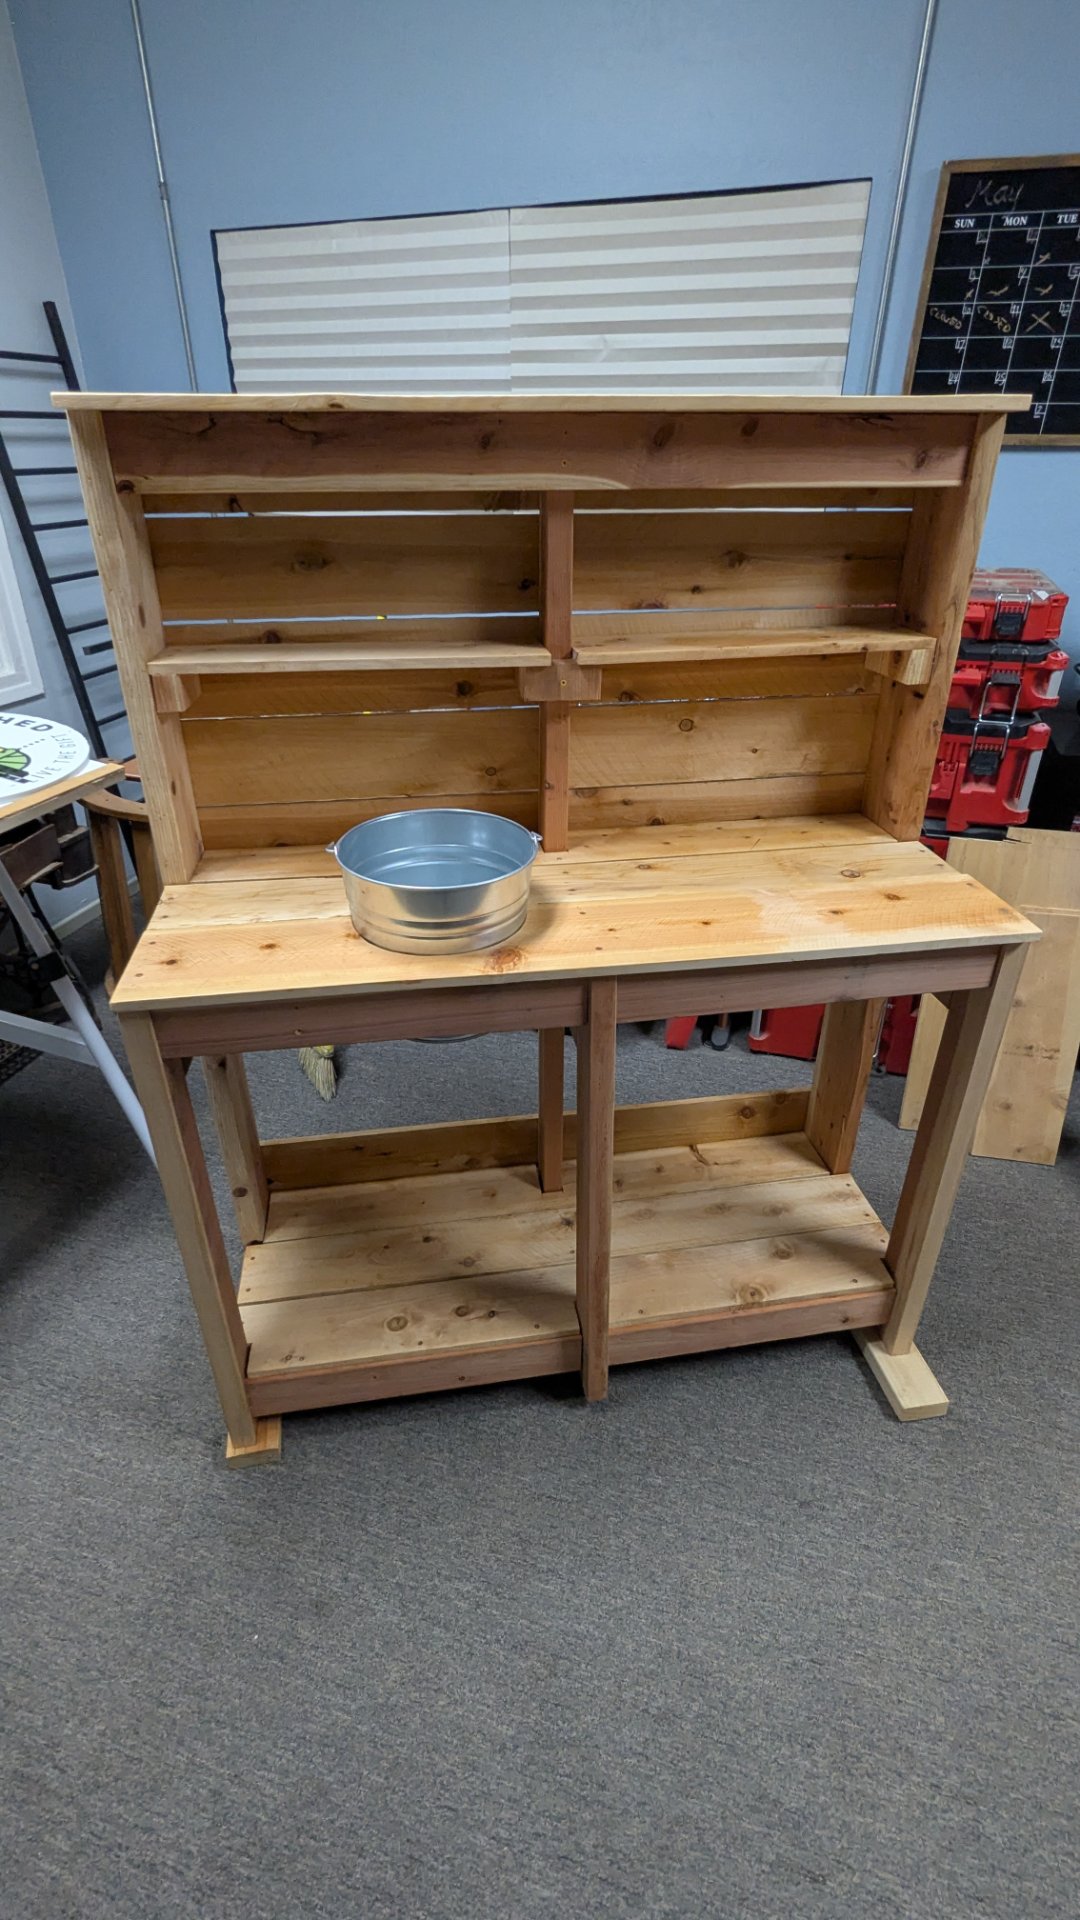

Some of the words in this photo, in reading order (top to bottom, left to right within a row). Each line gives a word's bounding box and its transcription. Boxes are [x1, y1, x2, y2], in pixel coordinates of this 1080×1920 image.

[964, 179, 1024, 212] May
[954, 218, 975, 228] SUN
[1003, 216, 1028, 226] MON
[1057, 214, 1078, 224] TUE
[28, 766, 62, 783] LIVE
[53, 751, 77, 763] THE
